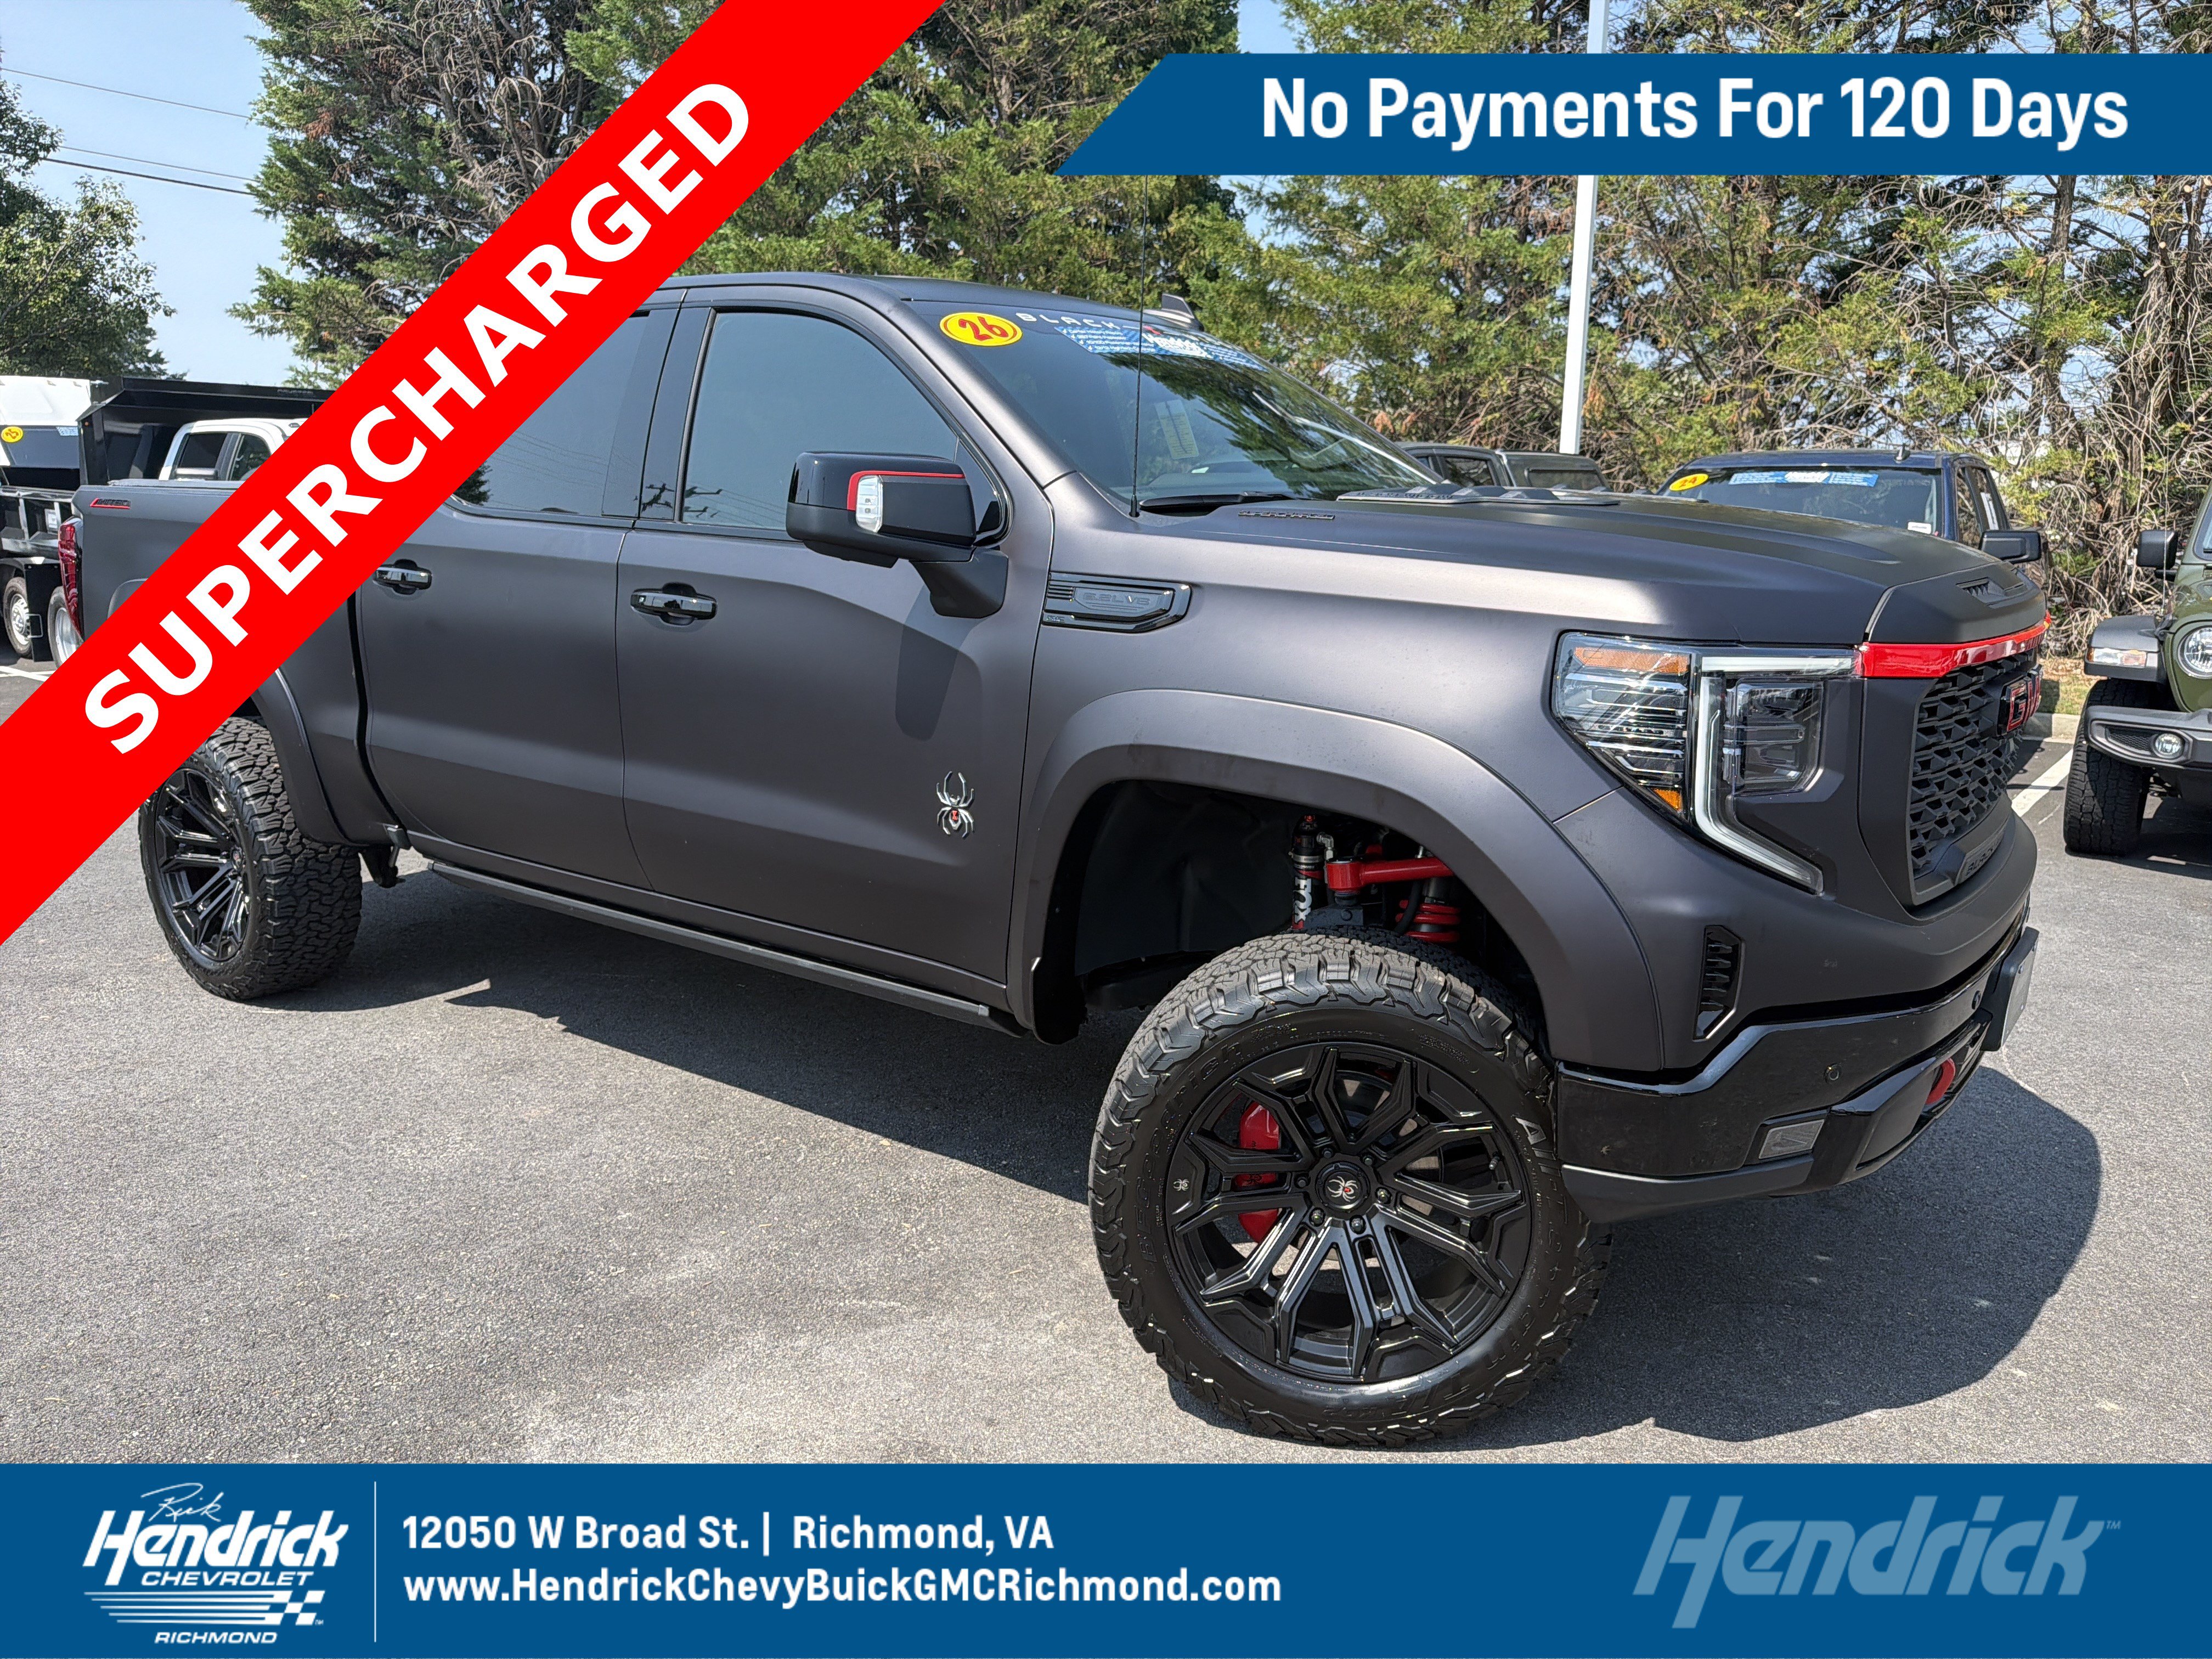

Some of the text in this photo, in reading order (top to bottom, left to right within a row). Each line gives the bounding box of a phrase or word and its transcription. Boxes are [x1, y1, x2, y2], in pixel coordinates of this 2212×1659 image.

[958, 315, 1009, 341] 26
[1015, 312, 1121, 330] BLACK
[1293, 876, 1313, 925] FOX
